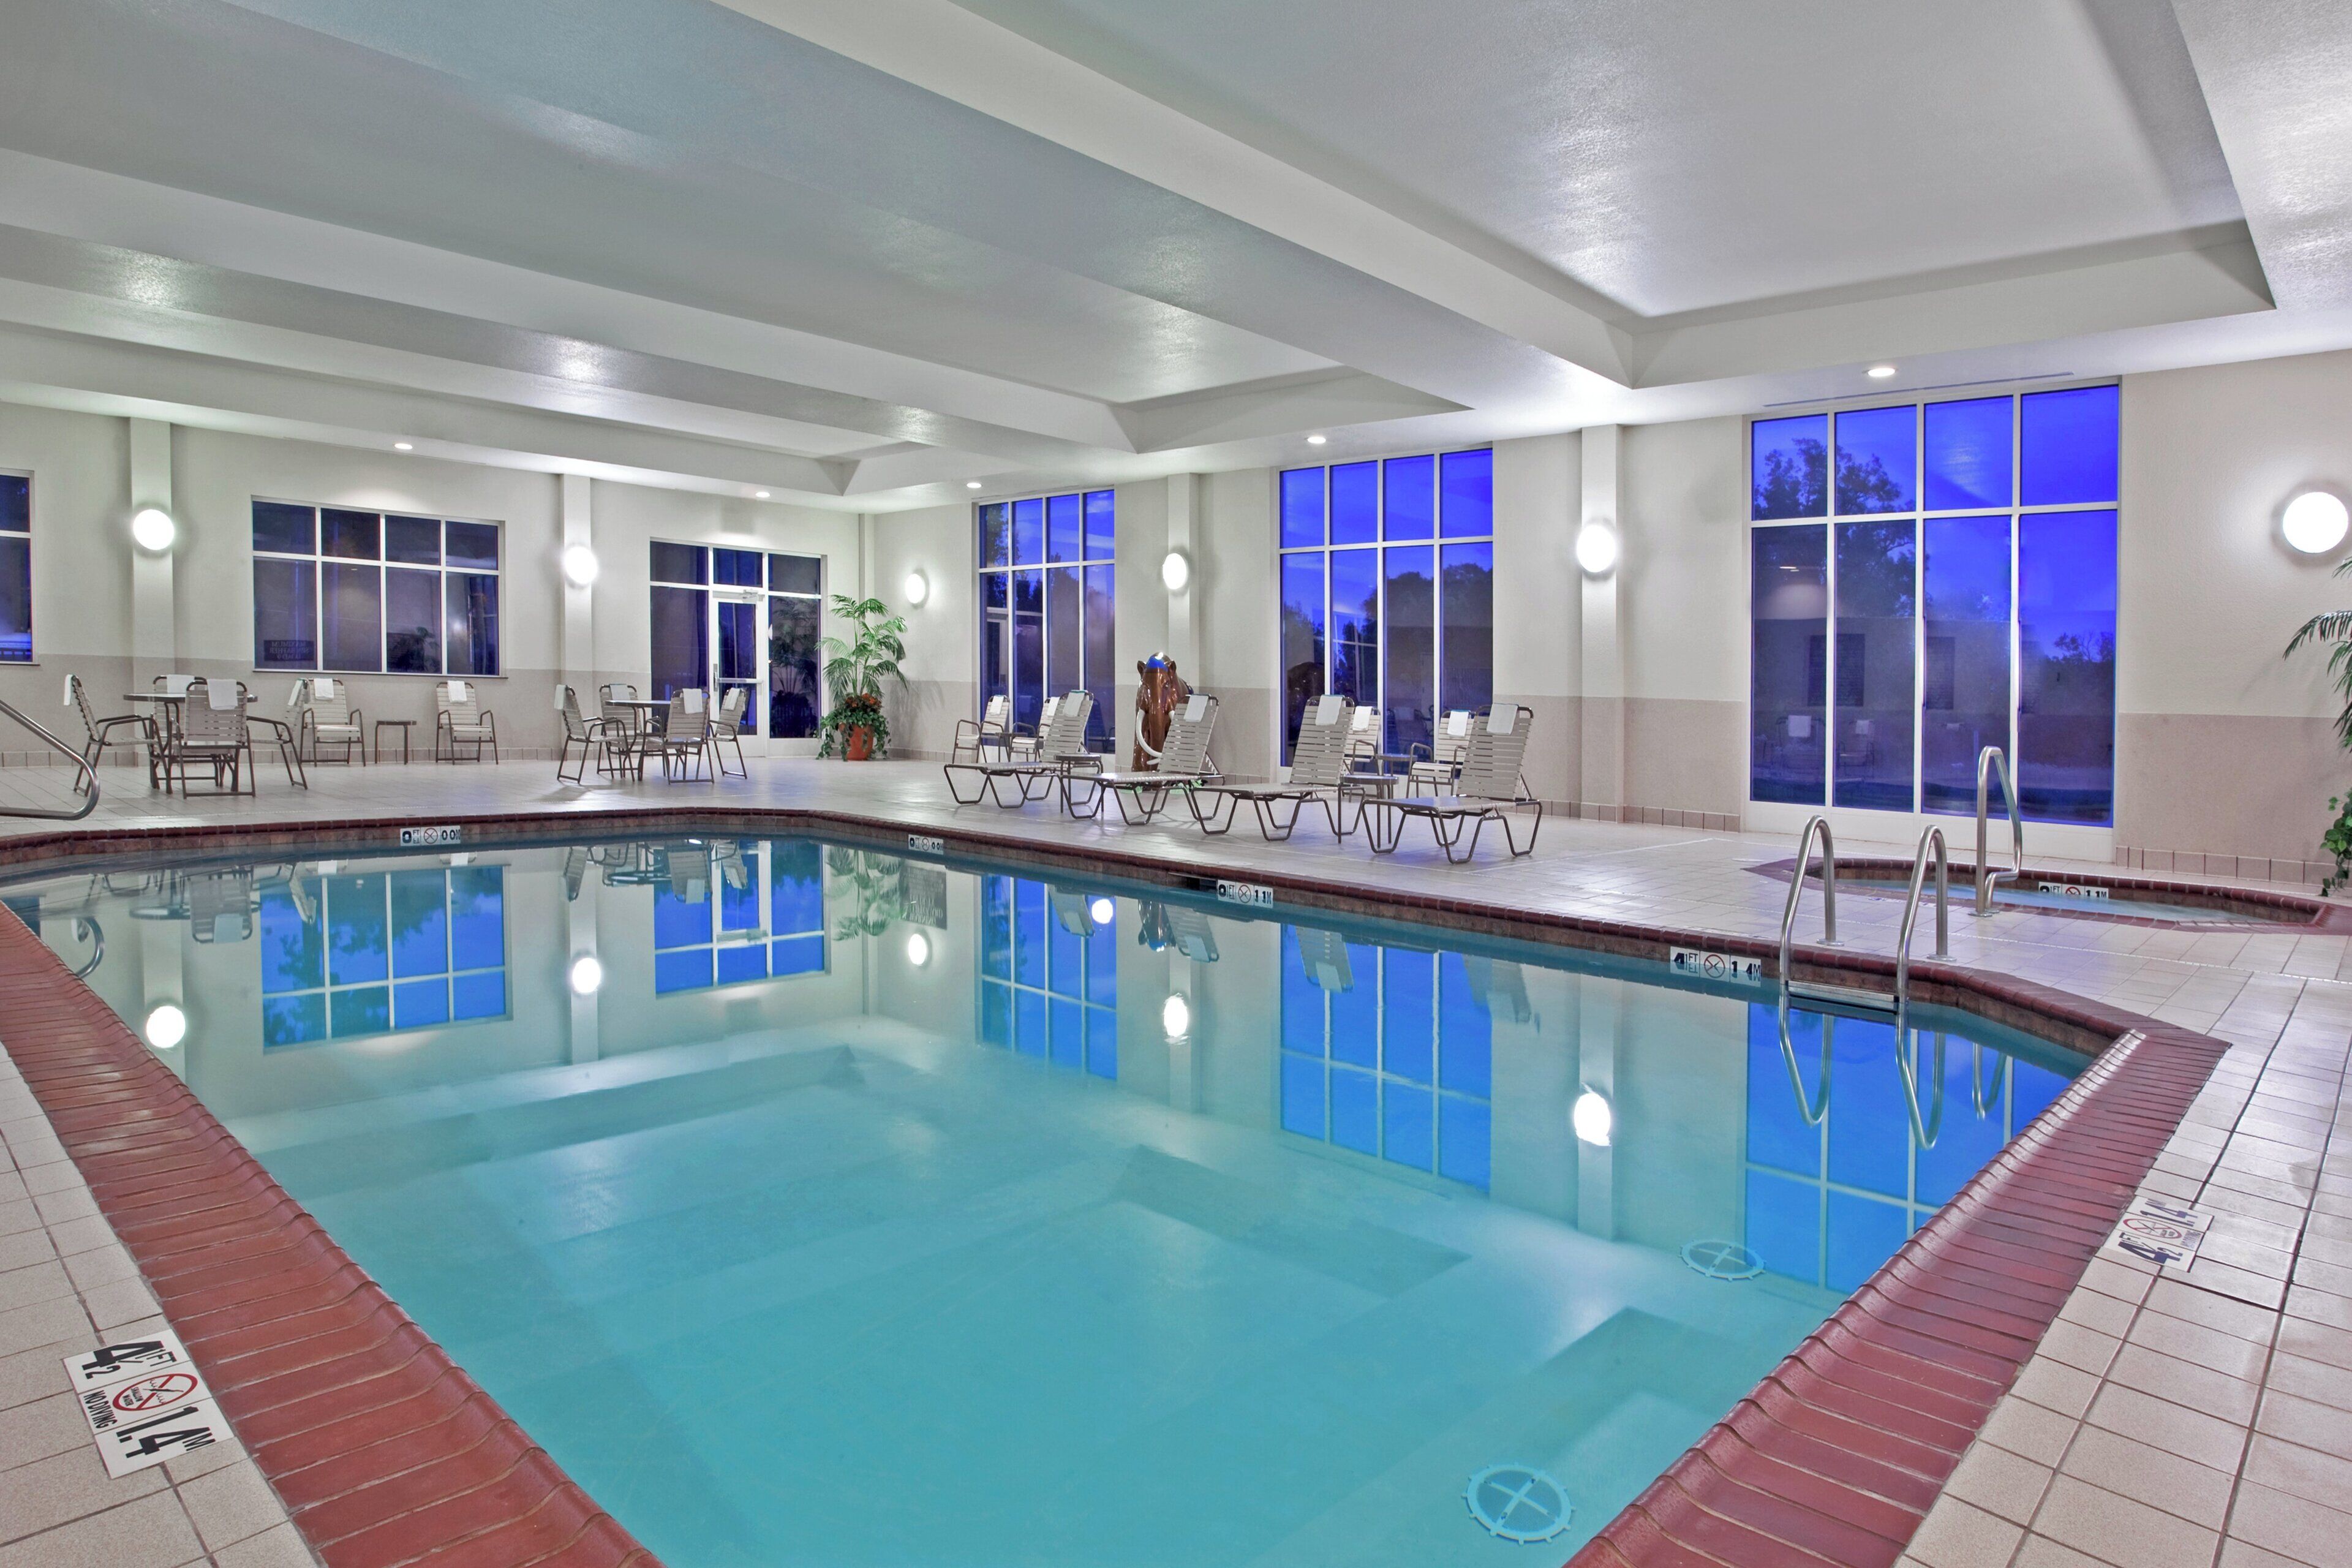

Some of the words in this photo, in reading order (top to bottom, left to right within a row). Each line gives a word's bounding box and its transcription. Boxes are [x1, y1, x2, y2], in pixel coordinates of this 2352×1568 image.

[1689, 953, 1698, 962] FT
[83, 1390, 107, 1404] NO
[88, 1400, 118, 1428] DIVING
